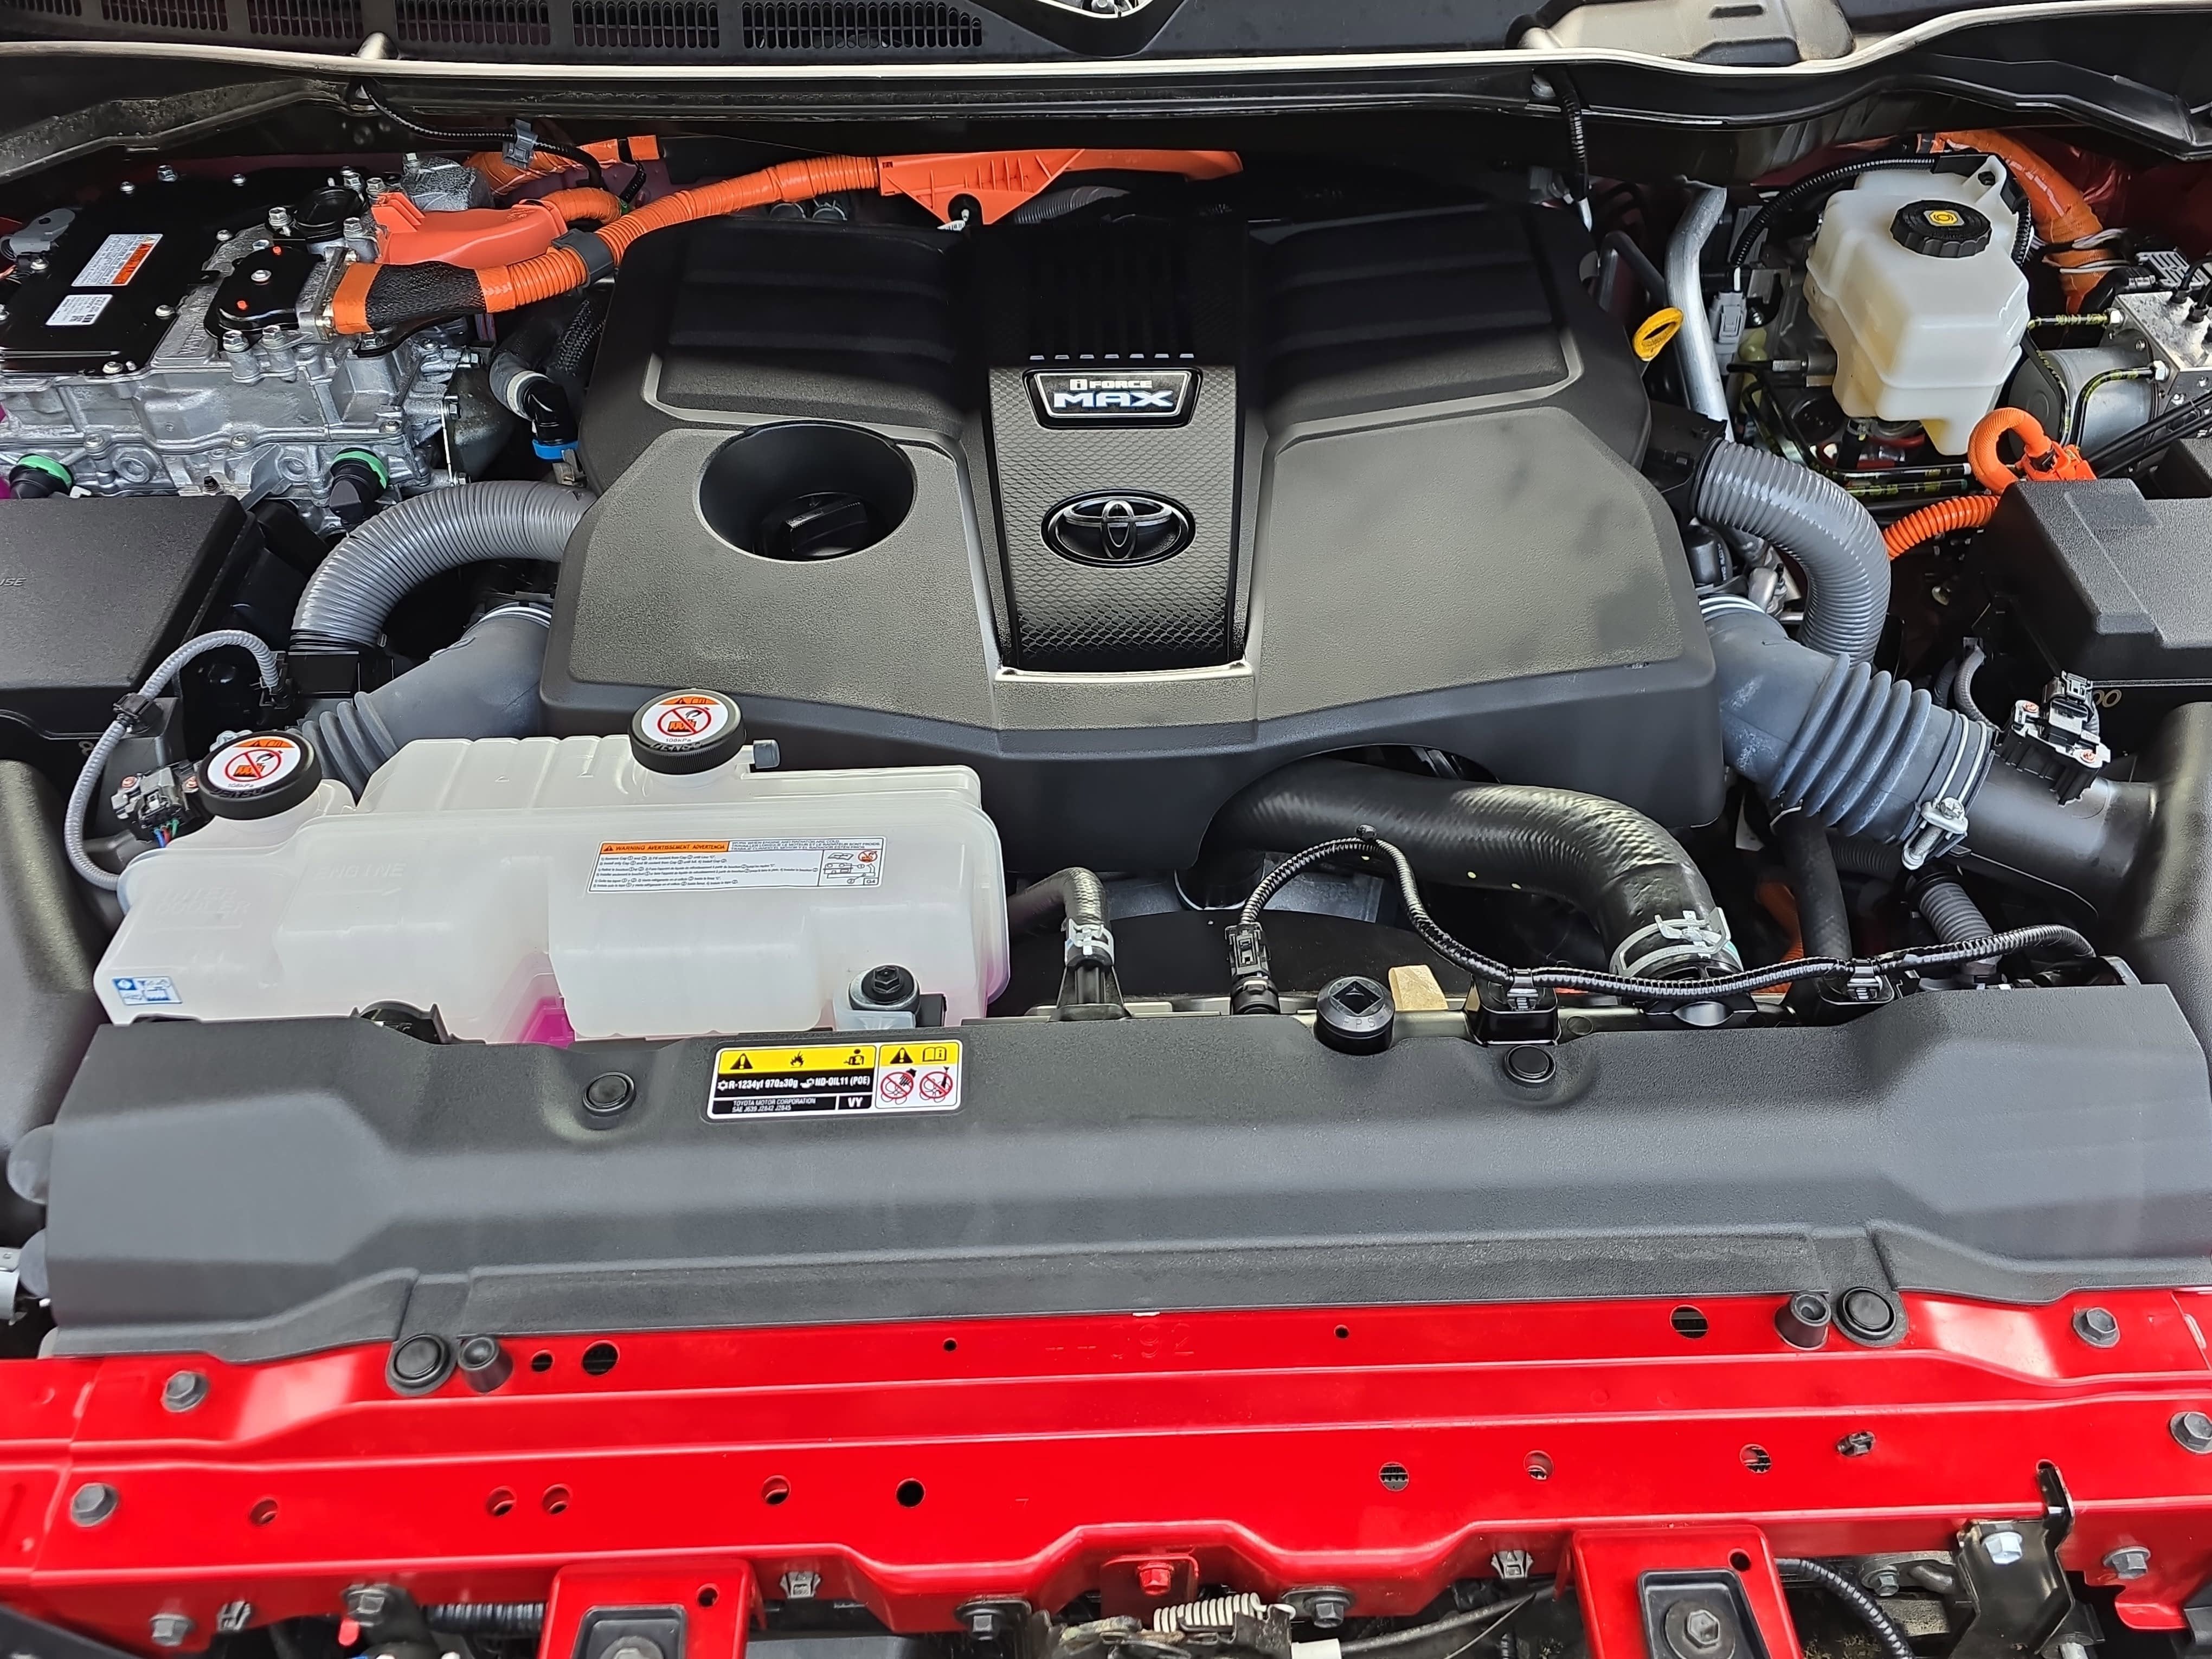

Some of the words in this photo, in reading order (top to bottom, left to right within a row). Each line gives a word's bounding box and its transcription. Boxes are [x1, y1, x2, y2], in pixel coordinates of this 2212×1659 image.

[1089, 380, 1152, 389] FORCE
[1053, 390, 1174, 408] MAX
[650, 742, 703, 752] DENSO
[850, 1076, 871, 1086] (POE)
[847, 1097, 863, 1108] VY
